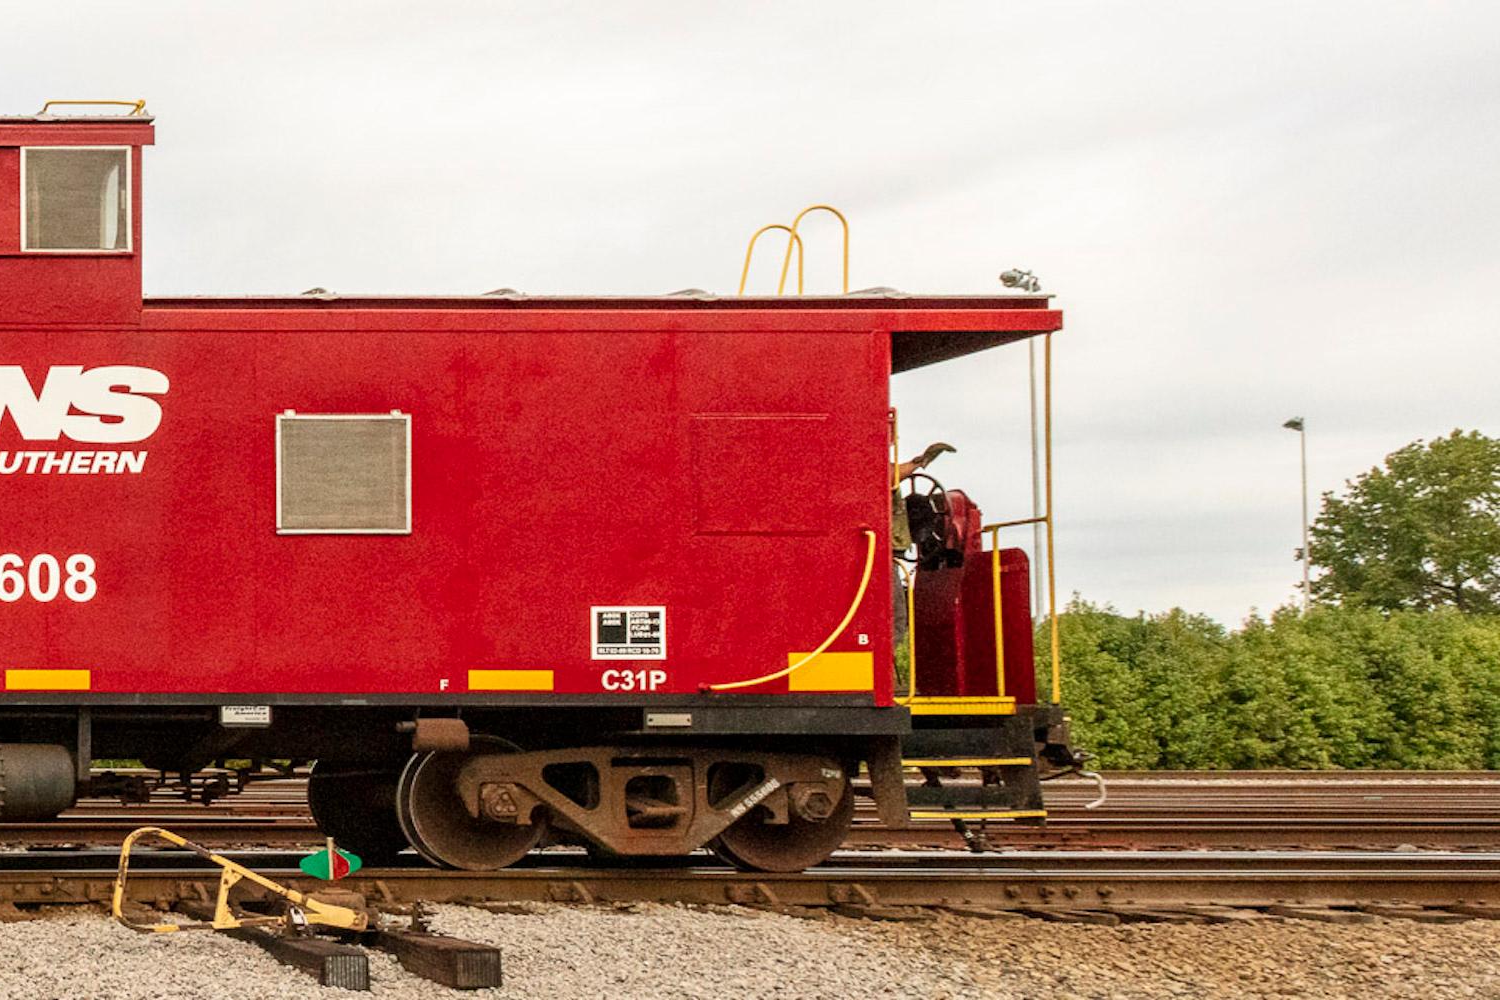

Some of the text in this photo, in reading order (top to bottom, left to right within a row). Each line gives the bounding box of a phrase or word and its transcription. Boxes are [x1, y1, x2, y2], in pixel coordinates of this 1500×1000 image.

[858, 633, 869, 645] B
[439, 678, 450, 690] F
[601, 669, 667, 691] C31P
